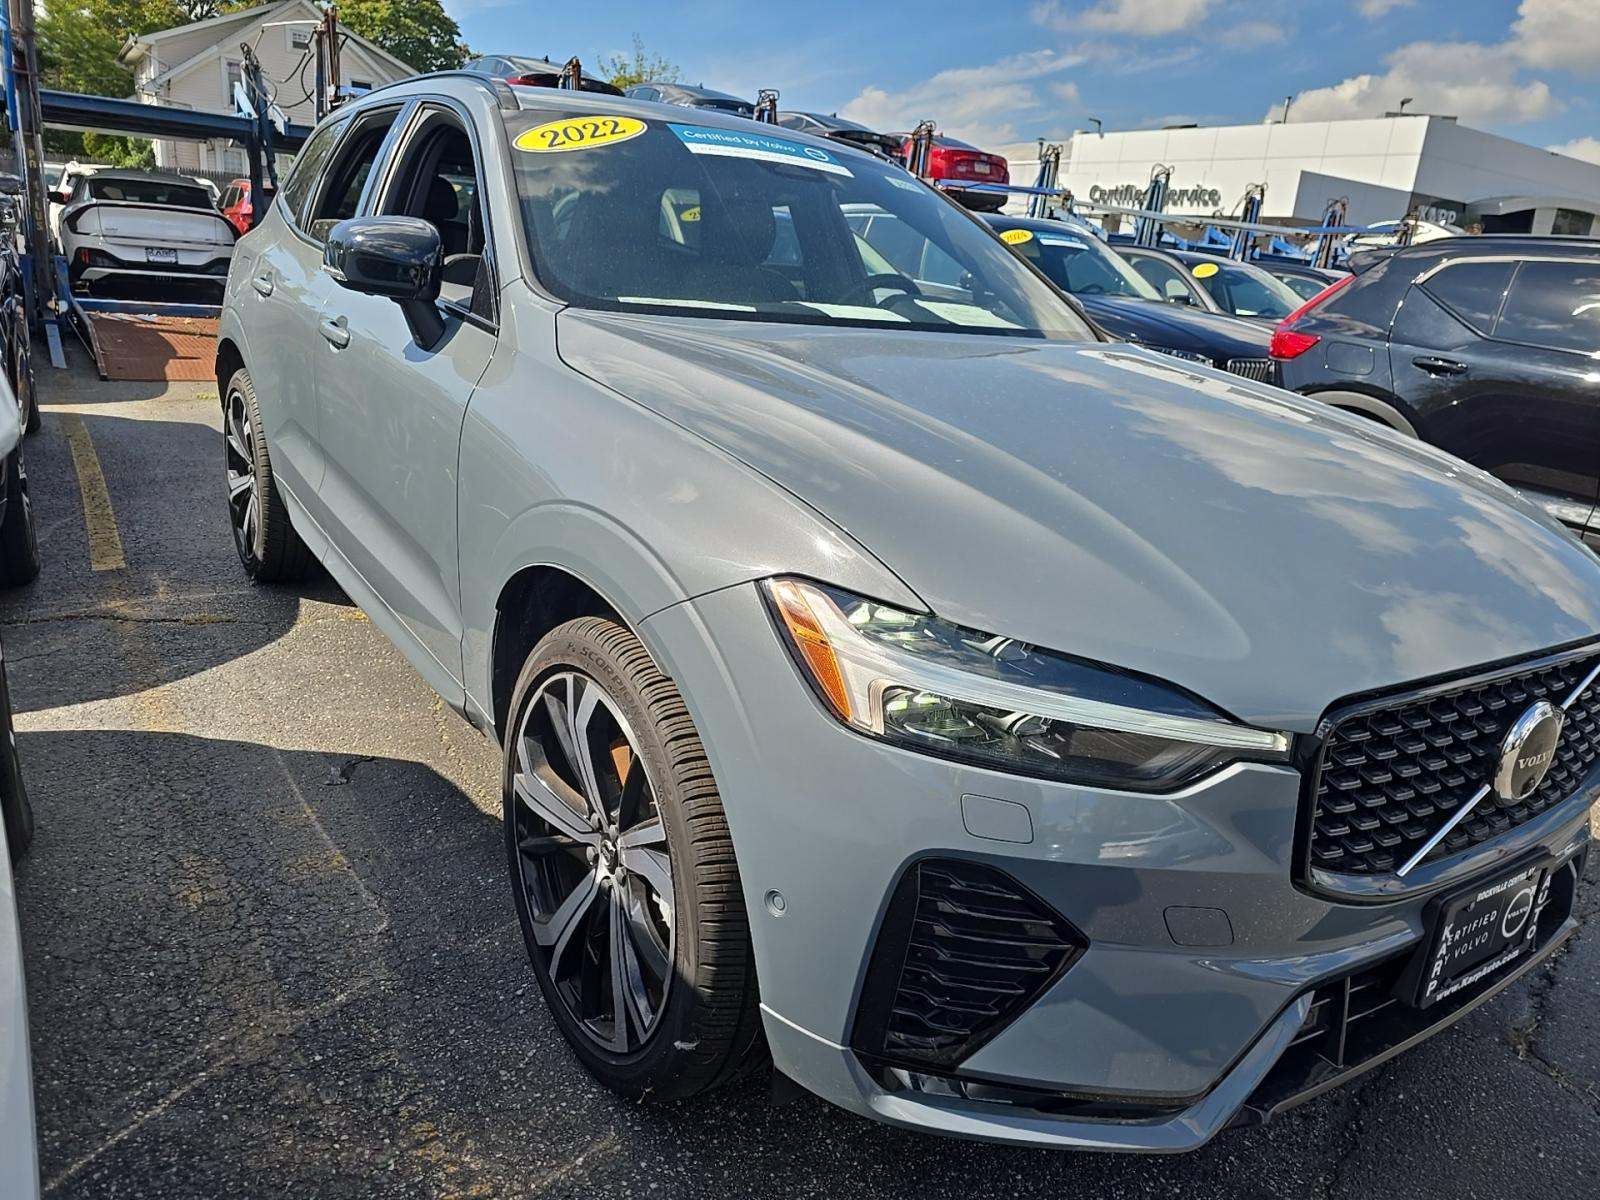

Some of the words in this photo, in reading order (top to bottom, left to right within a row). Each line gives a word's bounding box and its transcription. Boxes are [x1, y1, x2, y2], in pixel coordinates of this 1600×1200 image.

[540, 119, 626, 148] 2022
[683, 128, 741, 144] Certified
[741, 137, 760, 147] by
[759, 139, 797, 153] Volvo
[1089, 184, 1146, 207] Certifie
[1446, 910, 1497, 946] ERTIFIED
[1454, 931, 1488, 958] VOLVO
[1425, 923, 1454, 997] KARP
